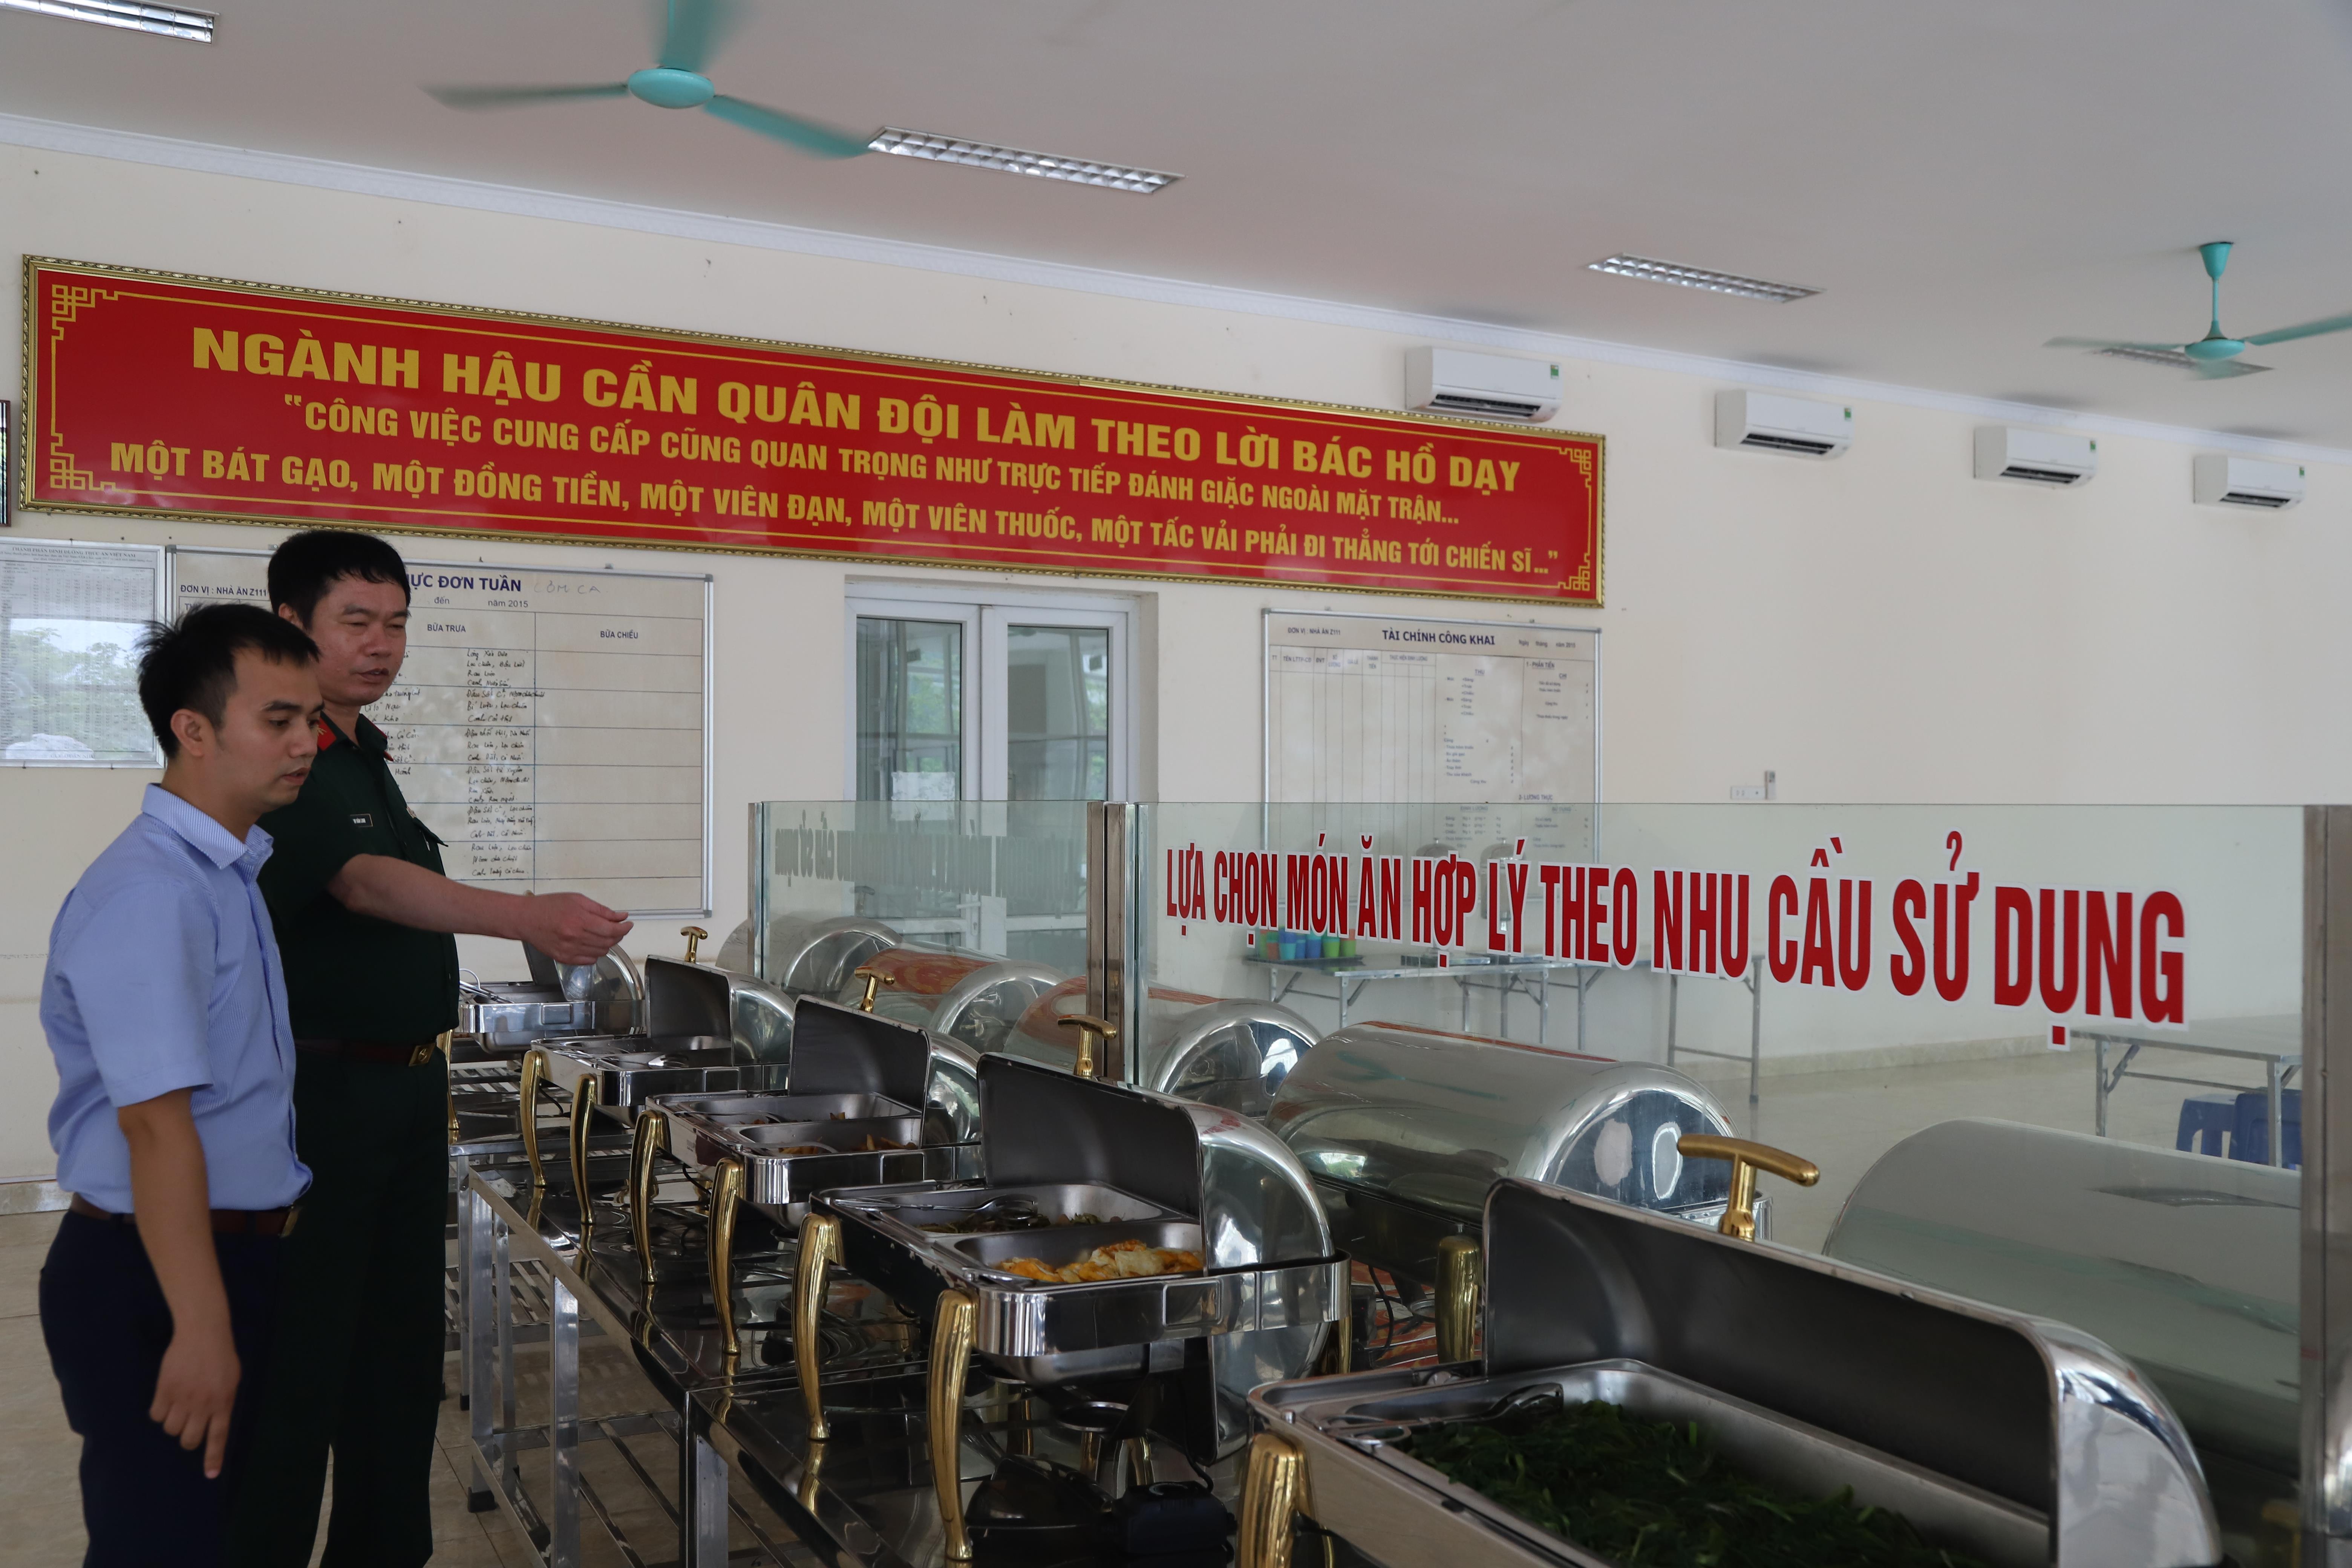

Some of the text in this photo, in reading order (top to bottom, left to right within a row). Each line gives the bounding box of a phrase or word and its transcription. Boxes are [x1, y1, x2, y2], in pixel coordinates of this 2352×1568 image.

[194, 328, 1520, 495] NGÀNH HẬU CẦN QUÂN ĐỘI LÀM THEO LỜI BÁC HỒ DẠY
[410, 408, 481, 446] VIỆC
[494, 418, 578, 450] CUNG
[591, 419, 650, 455] CẤP
[662, 428, 740, 462] CŨNG
[751, 440, 826, 470] QUAN
[839, 449, 926, 480] TRỌNG
[937, 456, 992, 483] NHƯ
[997, 462, 1060, 493] TRỰC
[1069, 463, 1120, 493] TIẾP
[1129, 470, 1193, 501] ĐÁNH
[1202, 477, 1253, 508] GIẶC
[1263, 485, 1329, 511] NGOÀI
[1337, 490, 1381, 519] MẶT
[112, 440, 190, 480] MỘT
[203, 447, 269, 481] BÁT
[282, 456, 357, 491] GẠO,
[374, 460, 444, 498] MỘT
[454, 462, 541, 501] ĐỒNG
[553, 471, 629, 510] TIỀN,
[641, 480, 704, 516] MỘT
[714, 485, 778, 518] VIÊN
[787, 495, 851, 526] ĐẠN,
[863, 498, 920, 532] MỘT
[929, 503, 986, 533] VIÊN
[995, 507, 1082, 541] THUỐC,
[1092, 515, 1143, 547] MỘT
[1150, 517, 1193, 547] TẤC
[1202, 520, 1237, 551] VẢI
[1246, 524, 1297, 555] PHẢI
[1305, 535, 1325, 557] ĐI
[1333, 529, 1401, 562] THẲNG
[1409, 538, 1439, 565] TỚI
[1447, 545, 1505, 570] CHIẾN
[181, 585, 199, 593] ĐƠN
[201, 586, 209, 595] VỊ
[217, 586, 234, 595] NHÀ
[237, 586, 247, 595] ĂN
[438, 575, 474, 590] ĐƠN
[479, 574, 521, 592] TUẦN
[434, 595, 450, 604] đến
[508, 600, 528, 608] 2015
[427, 623, 466, 632] BỮA TRƯA
[600, 629, 639, 639] BỮA CHIỀU
[1382, 629, 1495, 645] TÀI CHÍNH CÔNG KHAI
[1169, 844, 1204, 933] LỰA
[1216, 852, 1276, 943] CHỌN
[1288, 834, 1347, 933] MÓN
[1359, 838, 1400, 939] ĂN
[1414, 855, 1475, 966] HỢP
[1490, 840, 1527, 952] LÝ
[1542, 866, 1637, 965] THEO
[1655, 871, 1749, 977] NHU
[1770, 838, 1871, 990] CẦU
[1892, 832, 1978, 1001] SỬ
[1996, 887, 2183, 1044] DỤNG
